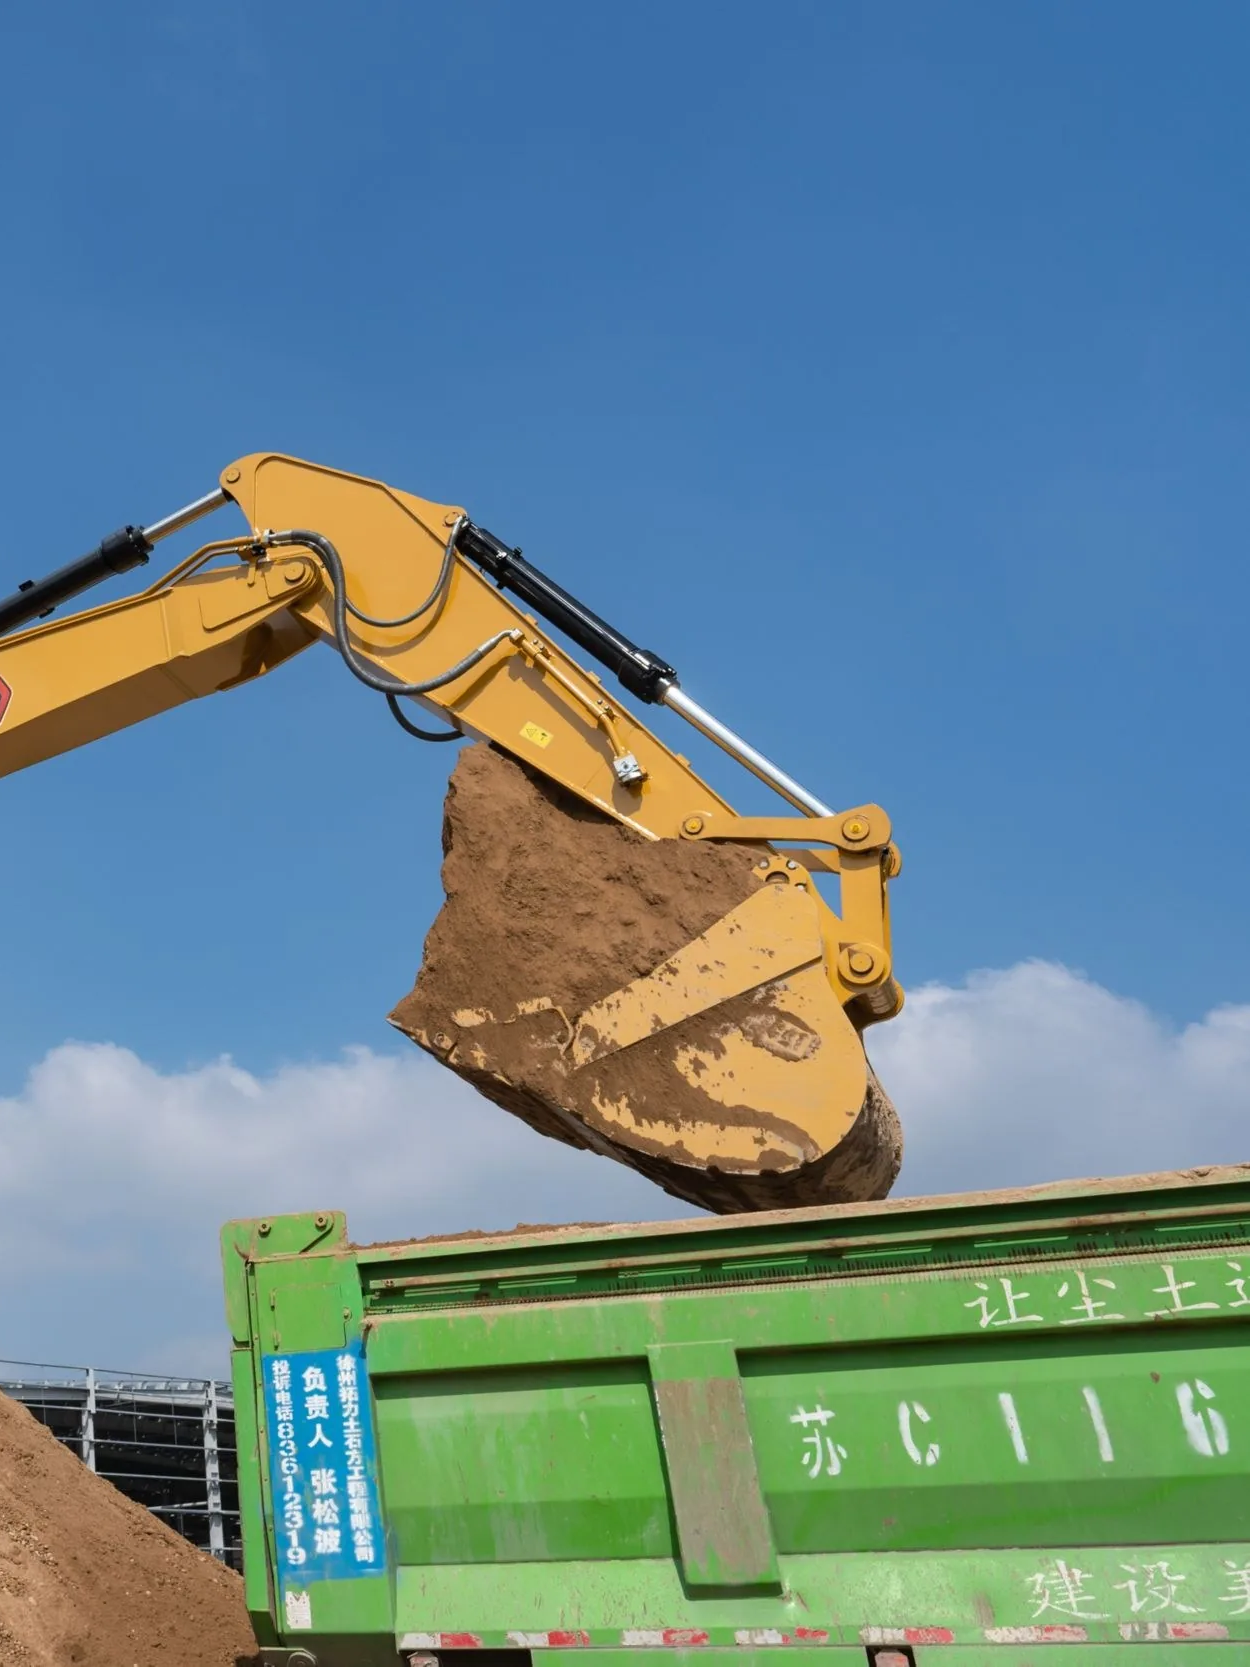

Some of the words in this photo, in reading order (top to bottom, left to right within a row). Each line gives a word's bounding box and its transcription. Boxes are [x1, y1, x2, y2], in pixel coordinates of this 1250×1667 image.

[302, 1365, 334, 1448] 负责人
[272, 1359, 306, 1566] 投诉电话83612319
[310, 1467, 342, 1555] 张松波
